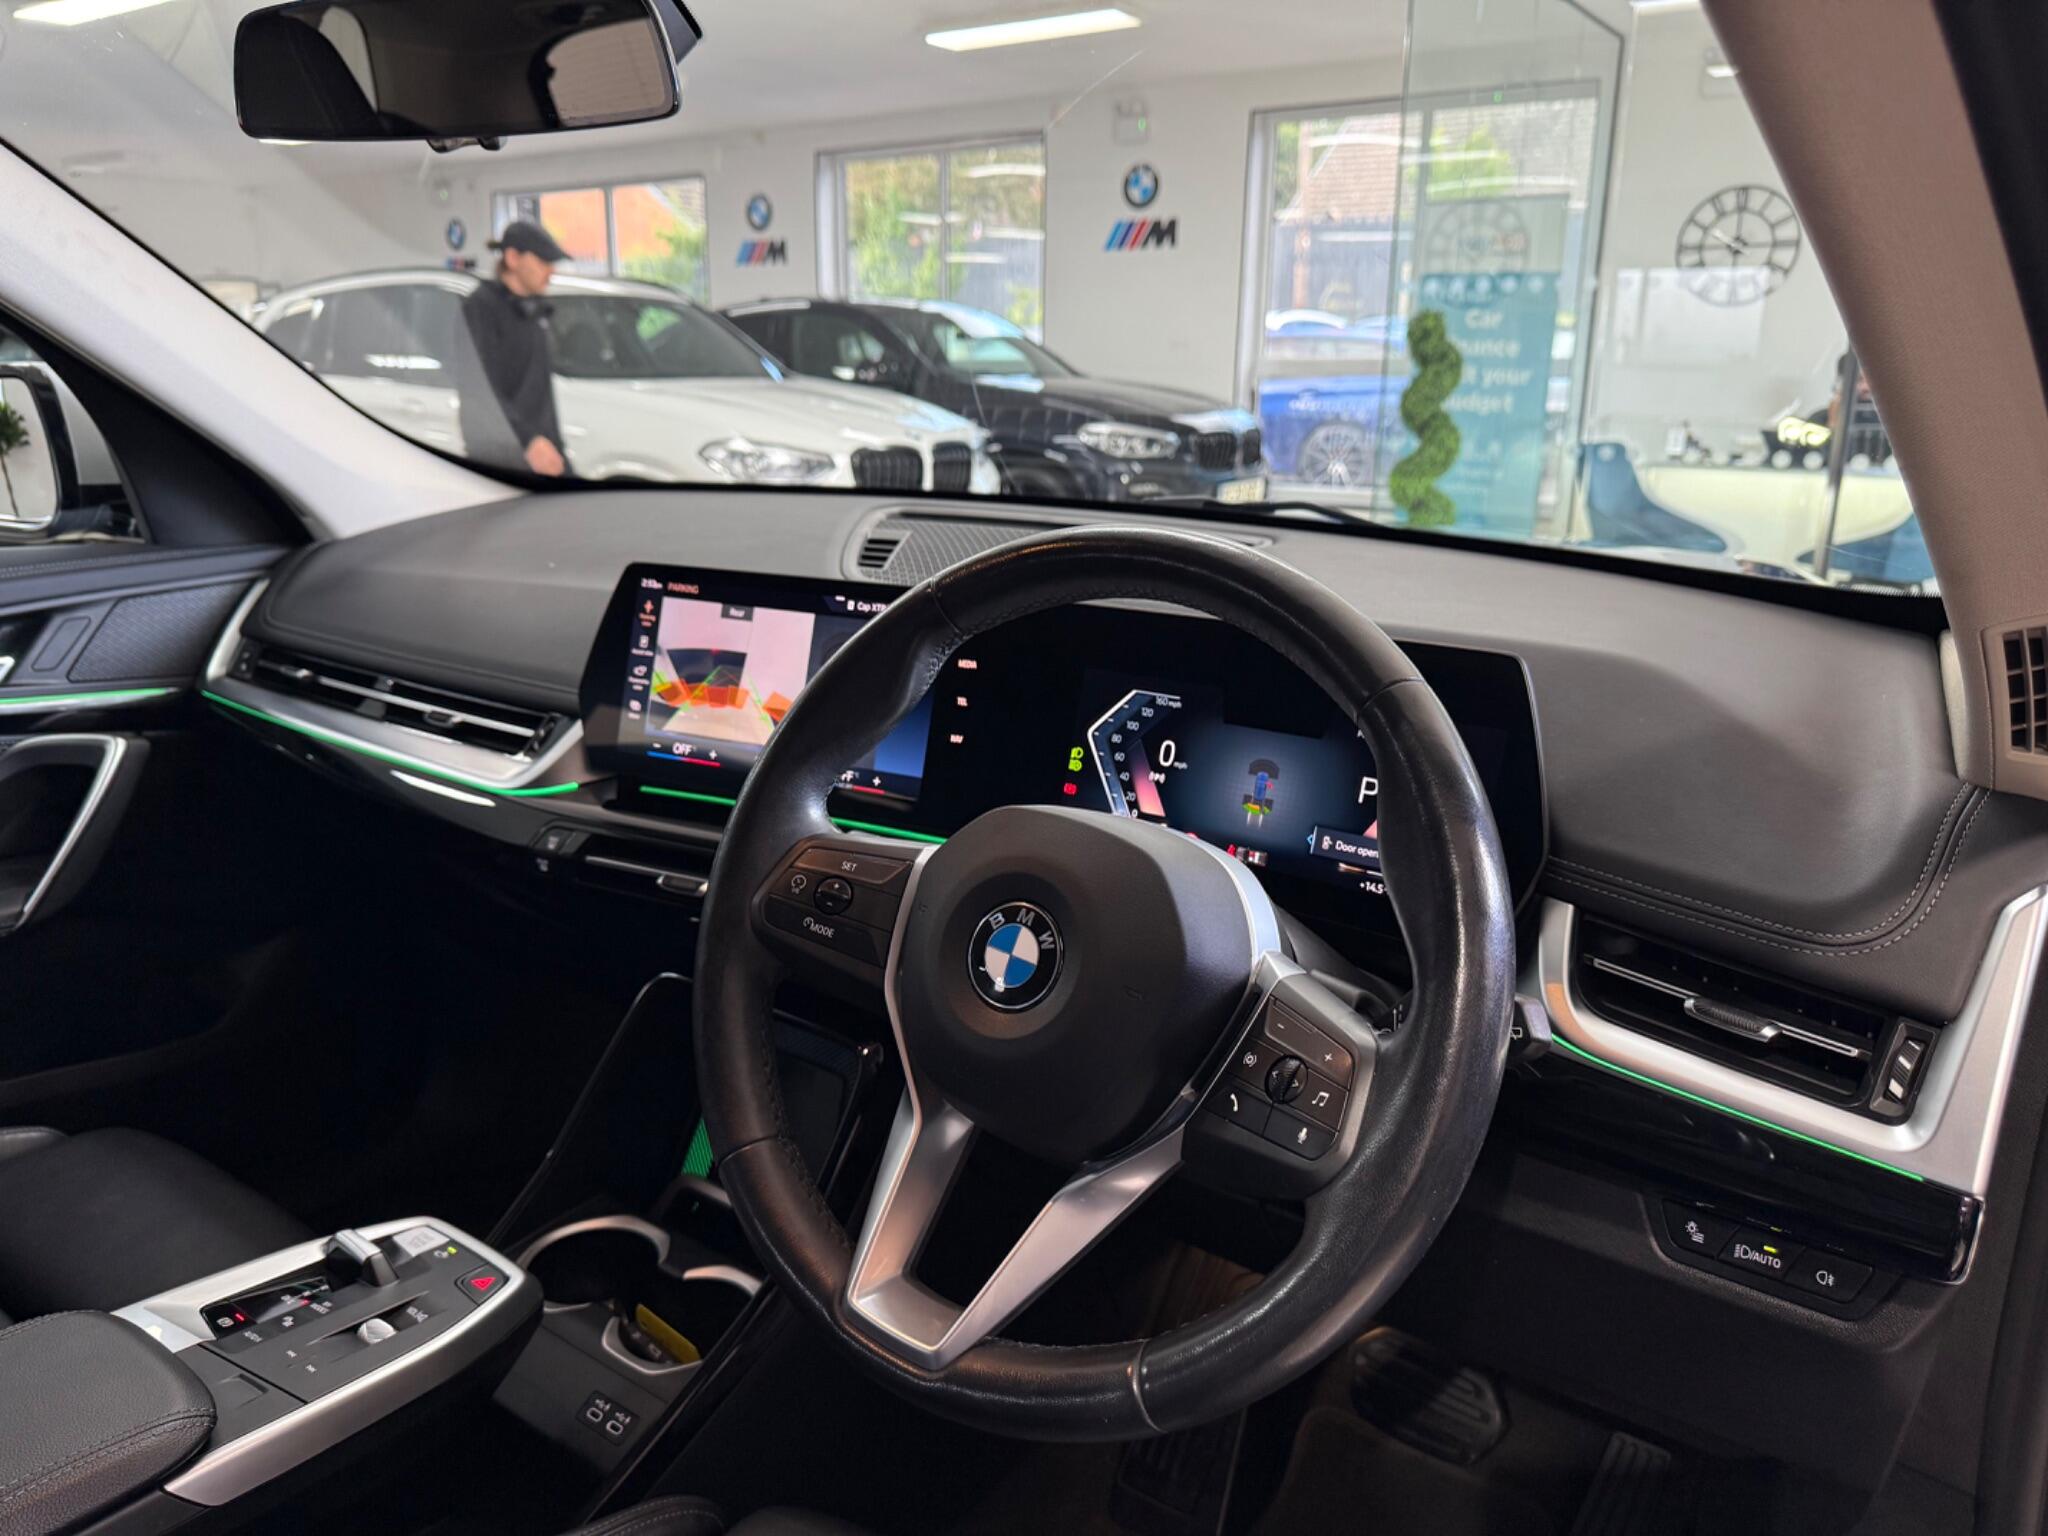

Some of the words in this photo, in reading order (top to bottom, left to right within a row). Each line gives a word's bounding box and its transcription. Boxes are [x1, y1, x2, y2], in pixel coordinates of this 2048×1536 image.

[1464, 309, 1503, 329] Car
[1482, 366, 1534, 389] your
[1445, 393, 1514, 416] udget
[667, 581, 699, 594] PARKING
[1155, 695, 1169, 706] 160
[1141, 706, 1154, 717] 120
[1126, 720, 1140, 731] 100
[1111, 733, 1123, 744] 80
[672, 741, 692, 756] OFF
[1159, 739, 1176, 767] 0
[1114, 751, 1126, 762] 60
[1120, 771, 1130, 781] 40
[1126, 791, 1137, 802] 20
[1357, 775, 1379, 804] P
[1335, 839, 1358, 854] Door
[841, 860, 858, 872] SET
[809, 922, 836, 938] MODE
[988, 907, 1055, 950] BMW
